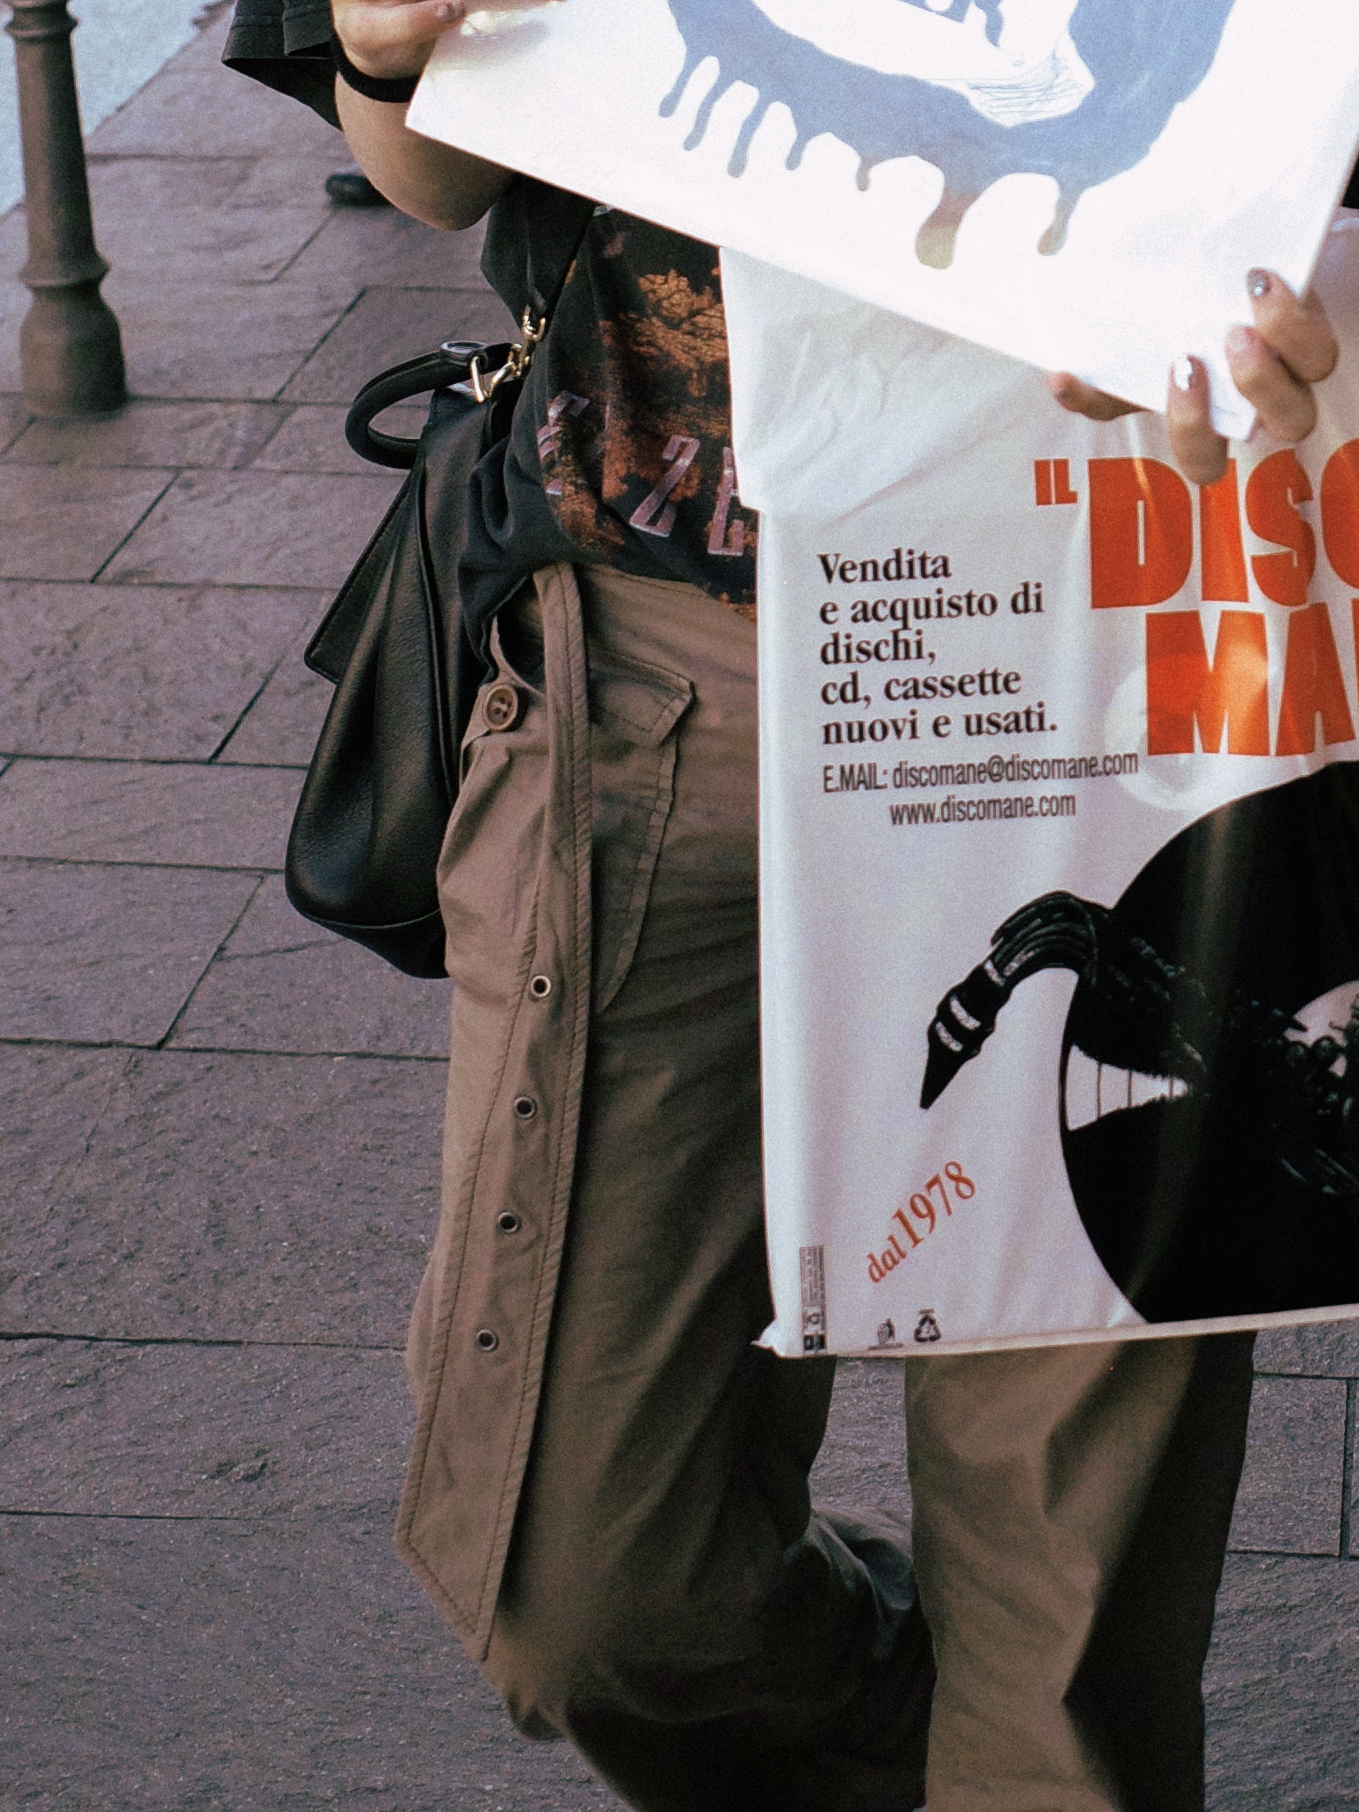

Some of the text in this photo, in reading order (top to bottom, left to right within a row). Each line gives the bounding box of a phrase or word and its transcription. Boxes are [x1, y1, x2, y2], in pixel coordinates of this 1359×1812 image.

[1034, 458, 1078, 506] IL
[817, 547, 952, 584] Vendita
[819, 580, 1045, 630] e acquisto di
[820, 628, 937, 666] dischi,
[821, 667, 1022, 709] cd, cassette
[822, 701, 1058, 745] nuovi e usati.
[822, 751, 1139, 794] E.MAIL: discomane@discomane.com
[889, 794, 1076, 826] www.discomane.com
